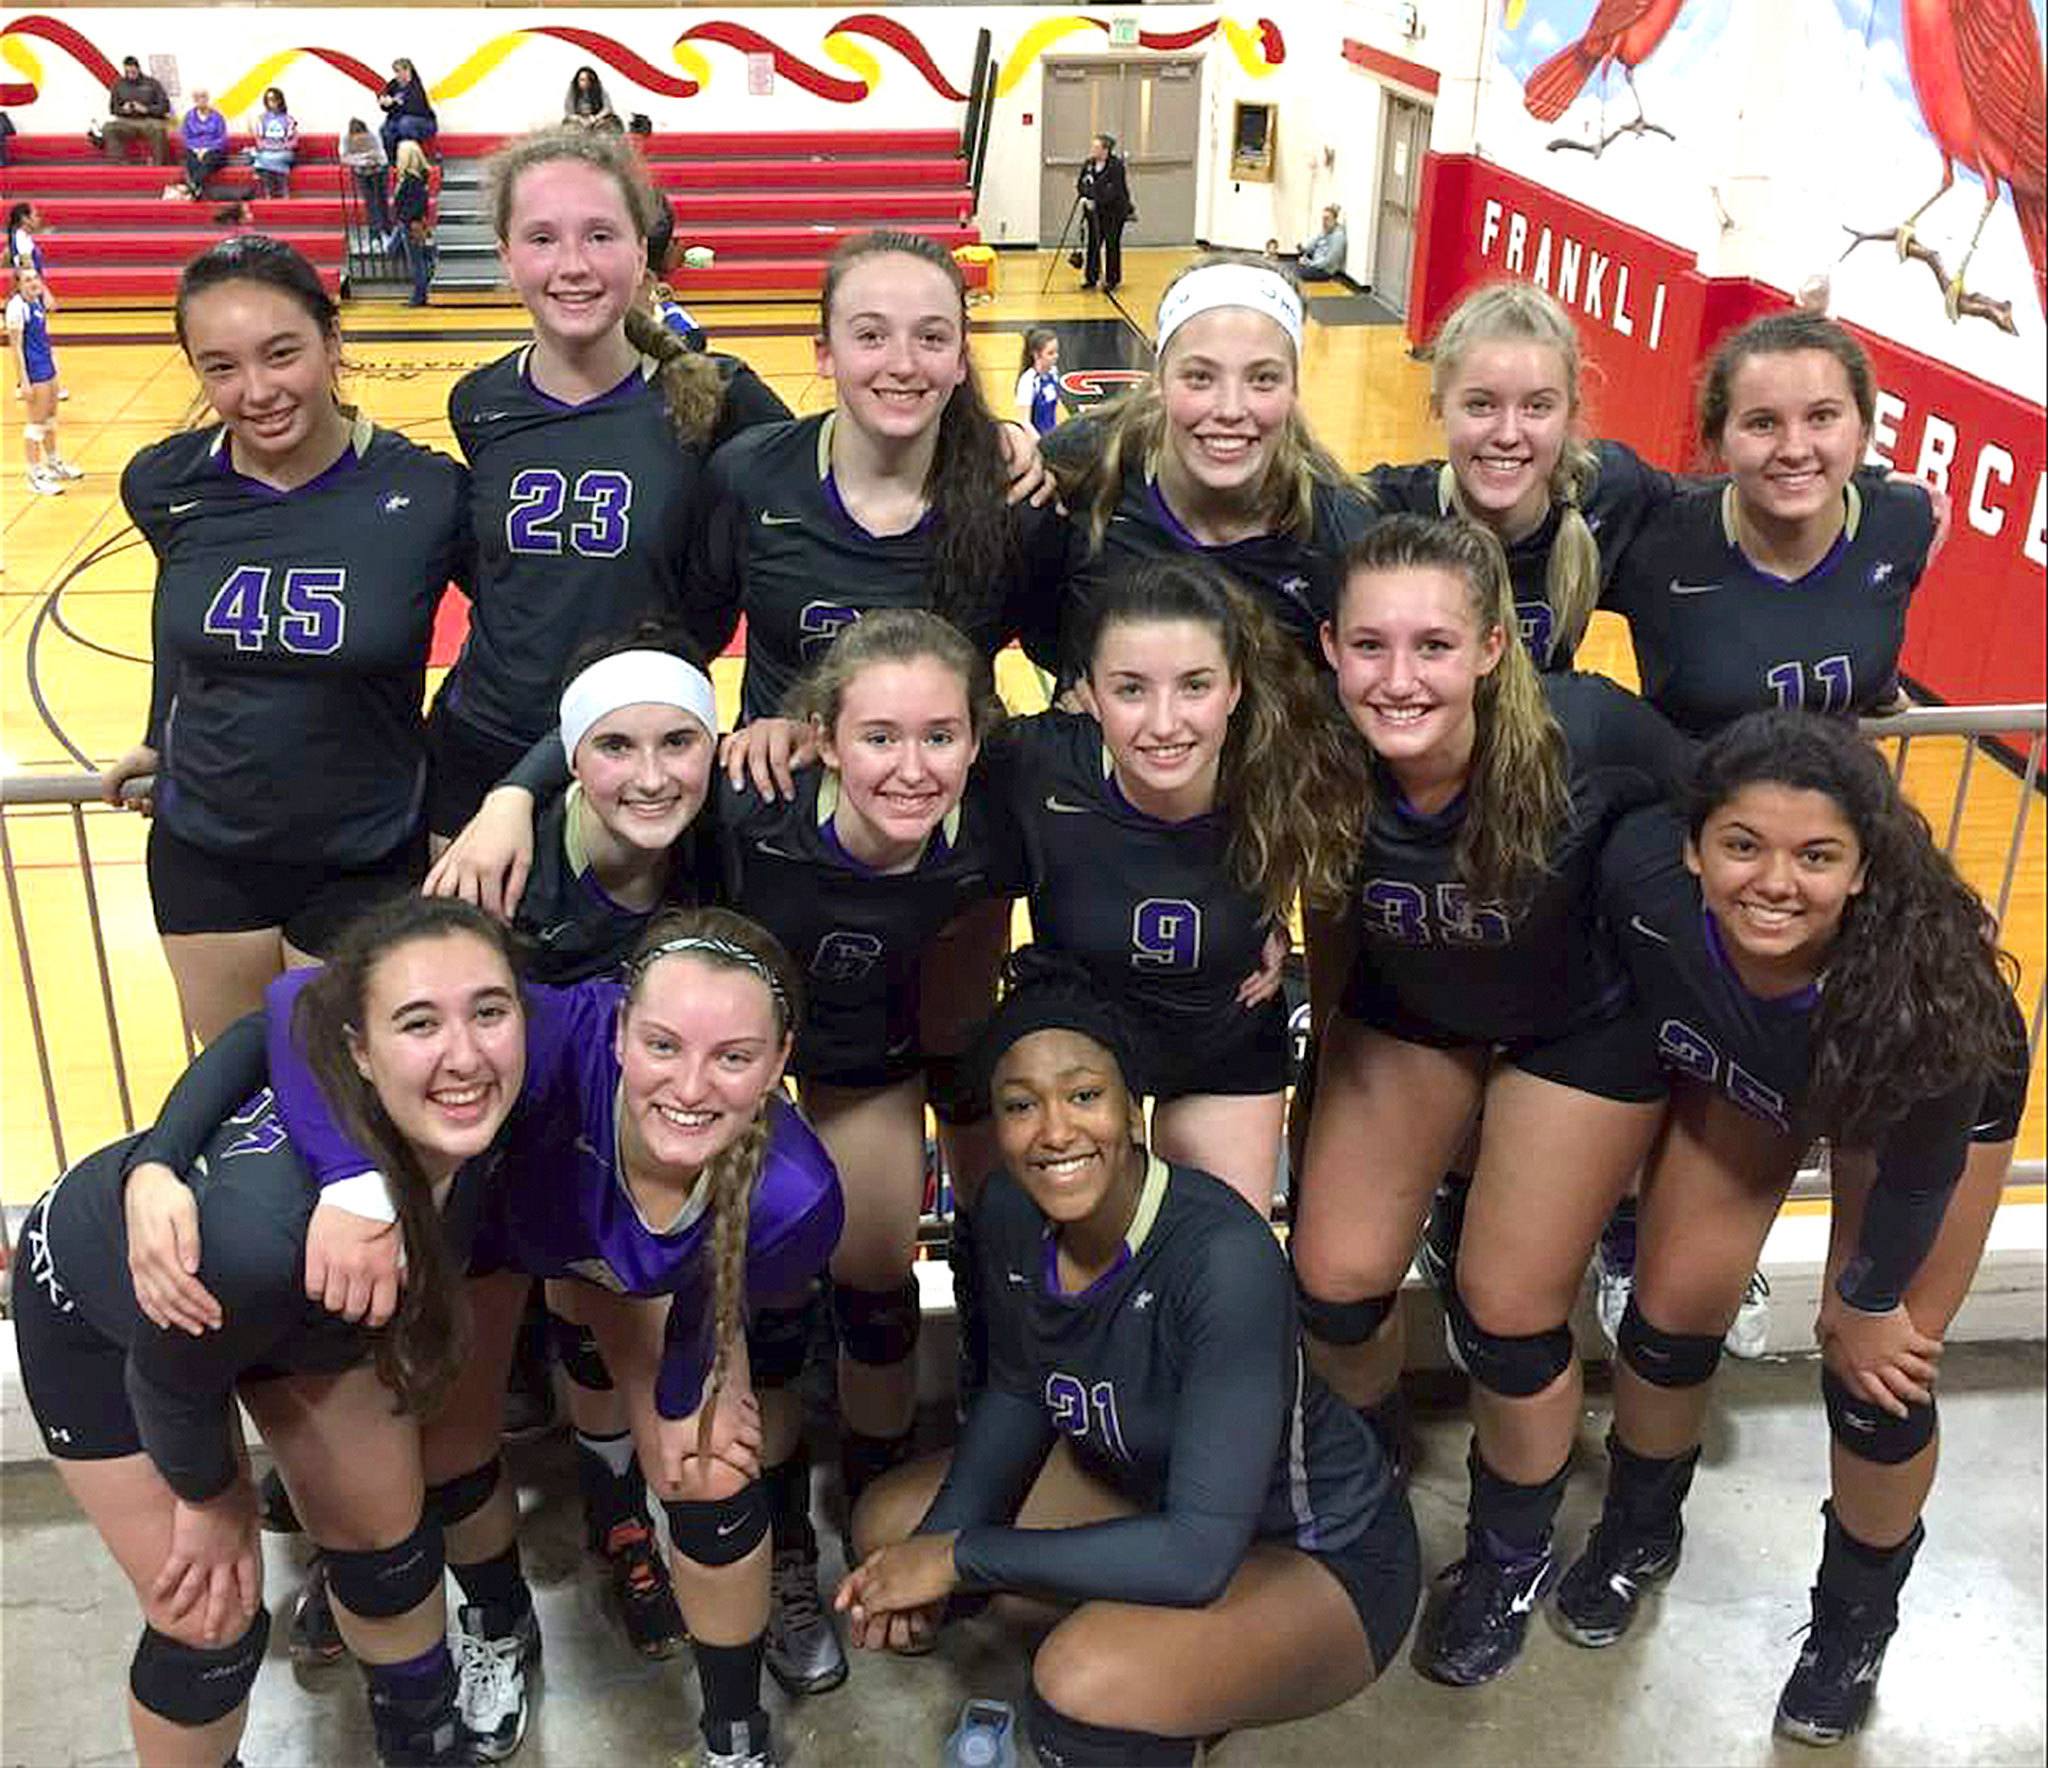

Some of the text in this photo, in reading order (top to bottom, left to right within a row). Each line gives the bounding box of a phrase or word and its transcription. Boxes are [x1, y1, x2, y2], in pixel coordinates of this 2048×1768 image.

[505, 468, 632, 558] 23
[203, 565, 346, 655] 45
[1767, 655, 1852, 712] 11
[1132, 898, 1200, 972] 9
